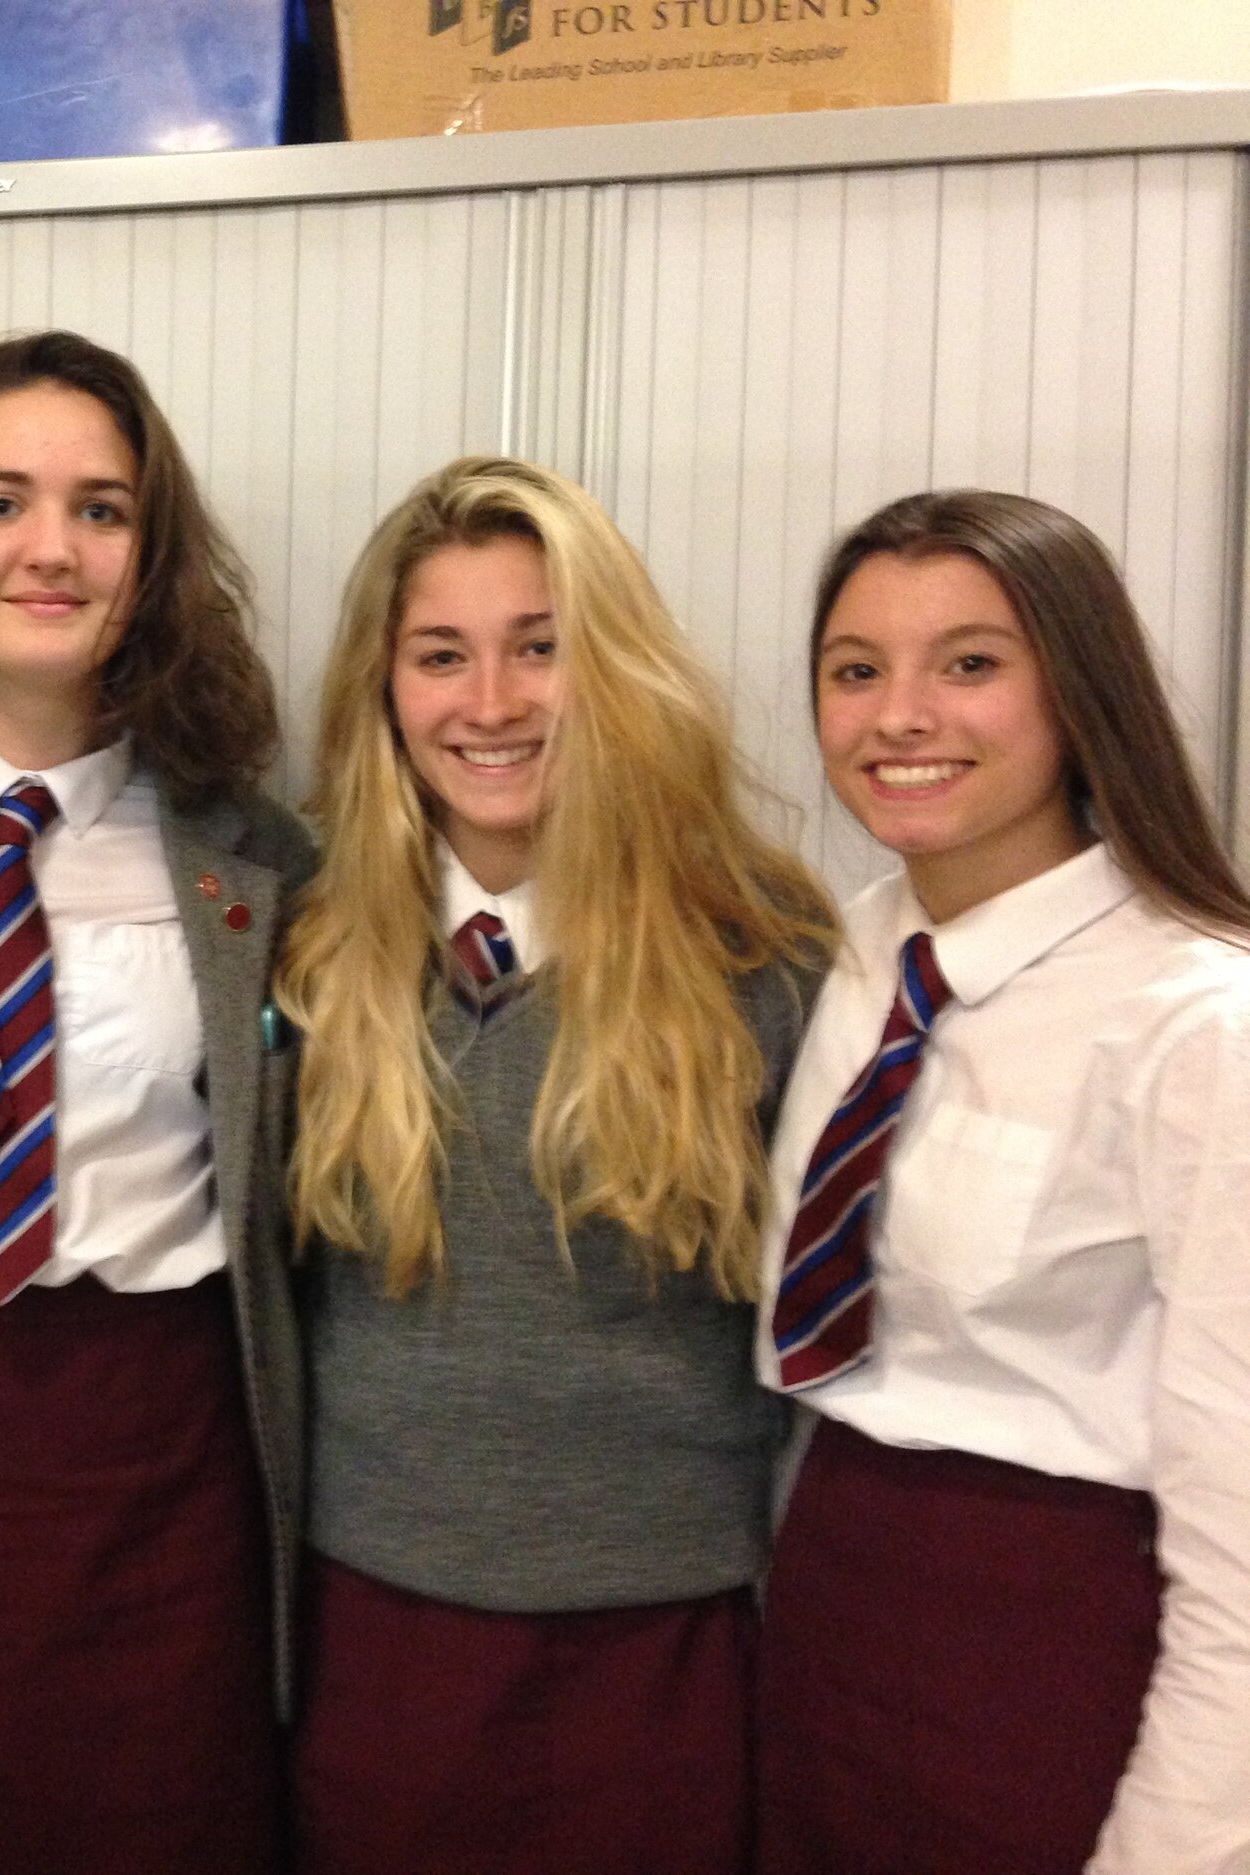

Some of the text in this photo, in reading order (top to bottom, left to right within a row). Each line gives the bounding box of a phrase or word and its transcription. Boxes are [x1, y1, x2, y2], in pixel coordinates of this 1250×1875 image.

[552, 4, 636, 37] FOR
[652, 0, 881, 30] STUDENTS
[469, 44, 849, 83] The Leading School and Library Supplier
